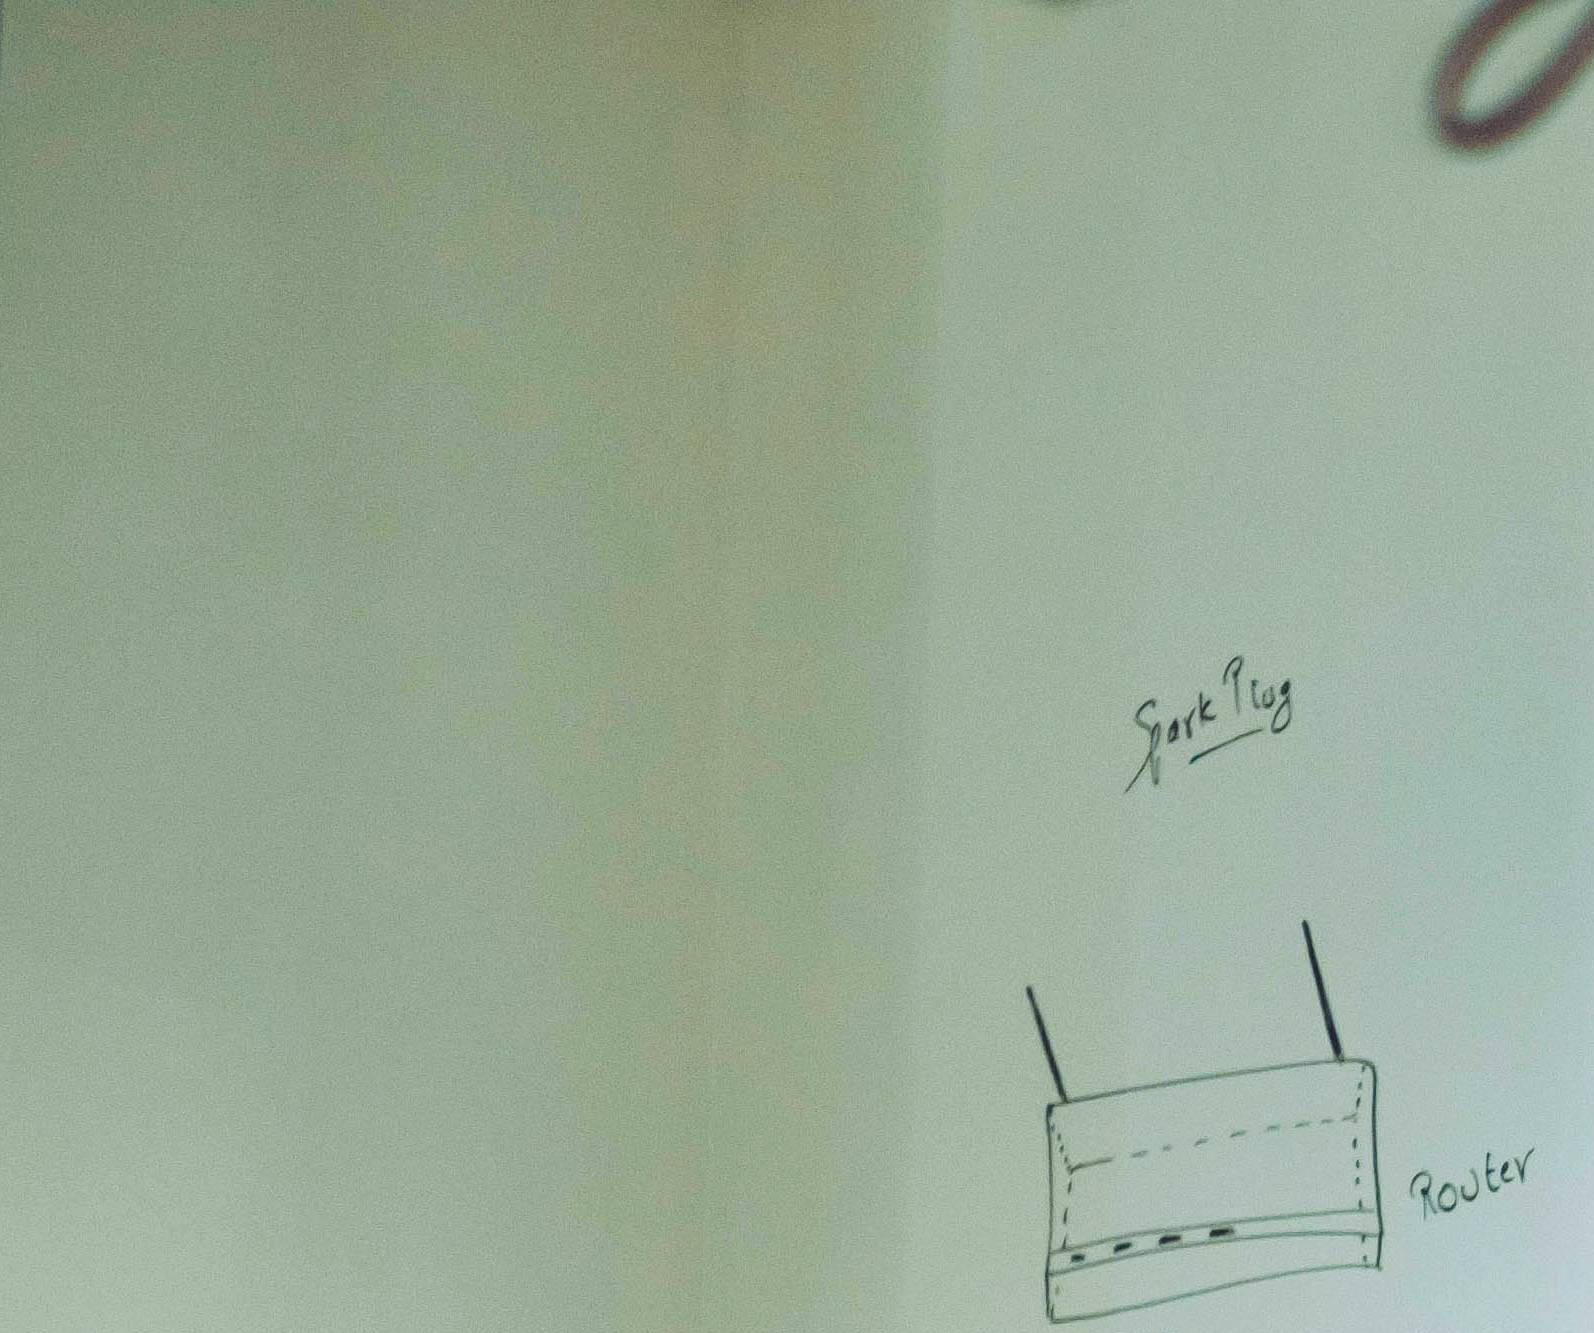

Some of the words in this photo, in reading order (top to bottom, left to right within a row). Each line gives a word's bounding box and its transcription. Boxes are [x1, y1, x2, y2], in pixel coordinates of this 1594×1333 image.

[1124, 691, 1217, 794] Spark
[1222, 655, 1292, 735] Plug
[1409, 1146, 1536, 1221] Router
